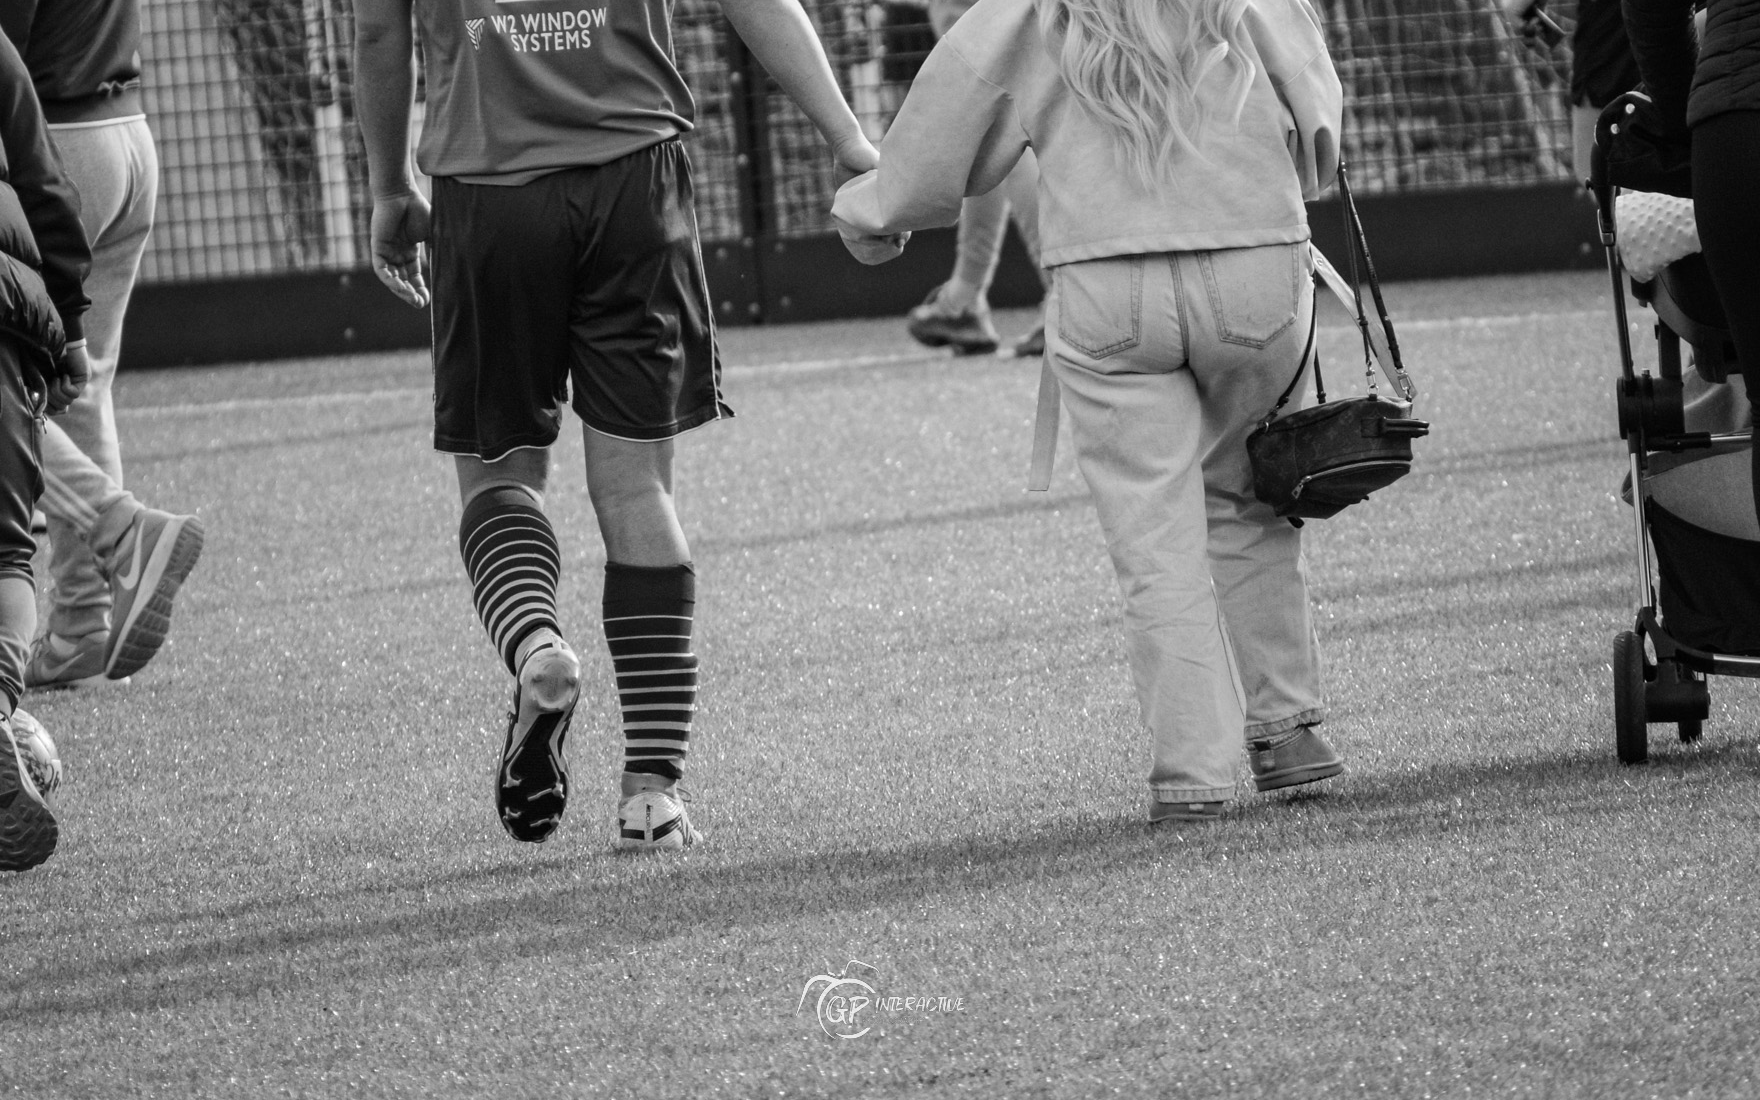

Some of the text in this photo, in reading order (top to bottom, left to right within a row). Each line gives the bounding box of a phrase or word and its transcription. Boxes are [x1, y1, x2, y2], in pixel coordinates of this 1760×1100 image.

[490, 7, 607, 34] W2 WINDOW
[511, 30, 591, 52] SYSTEMS
